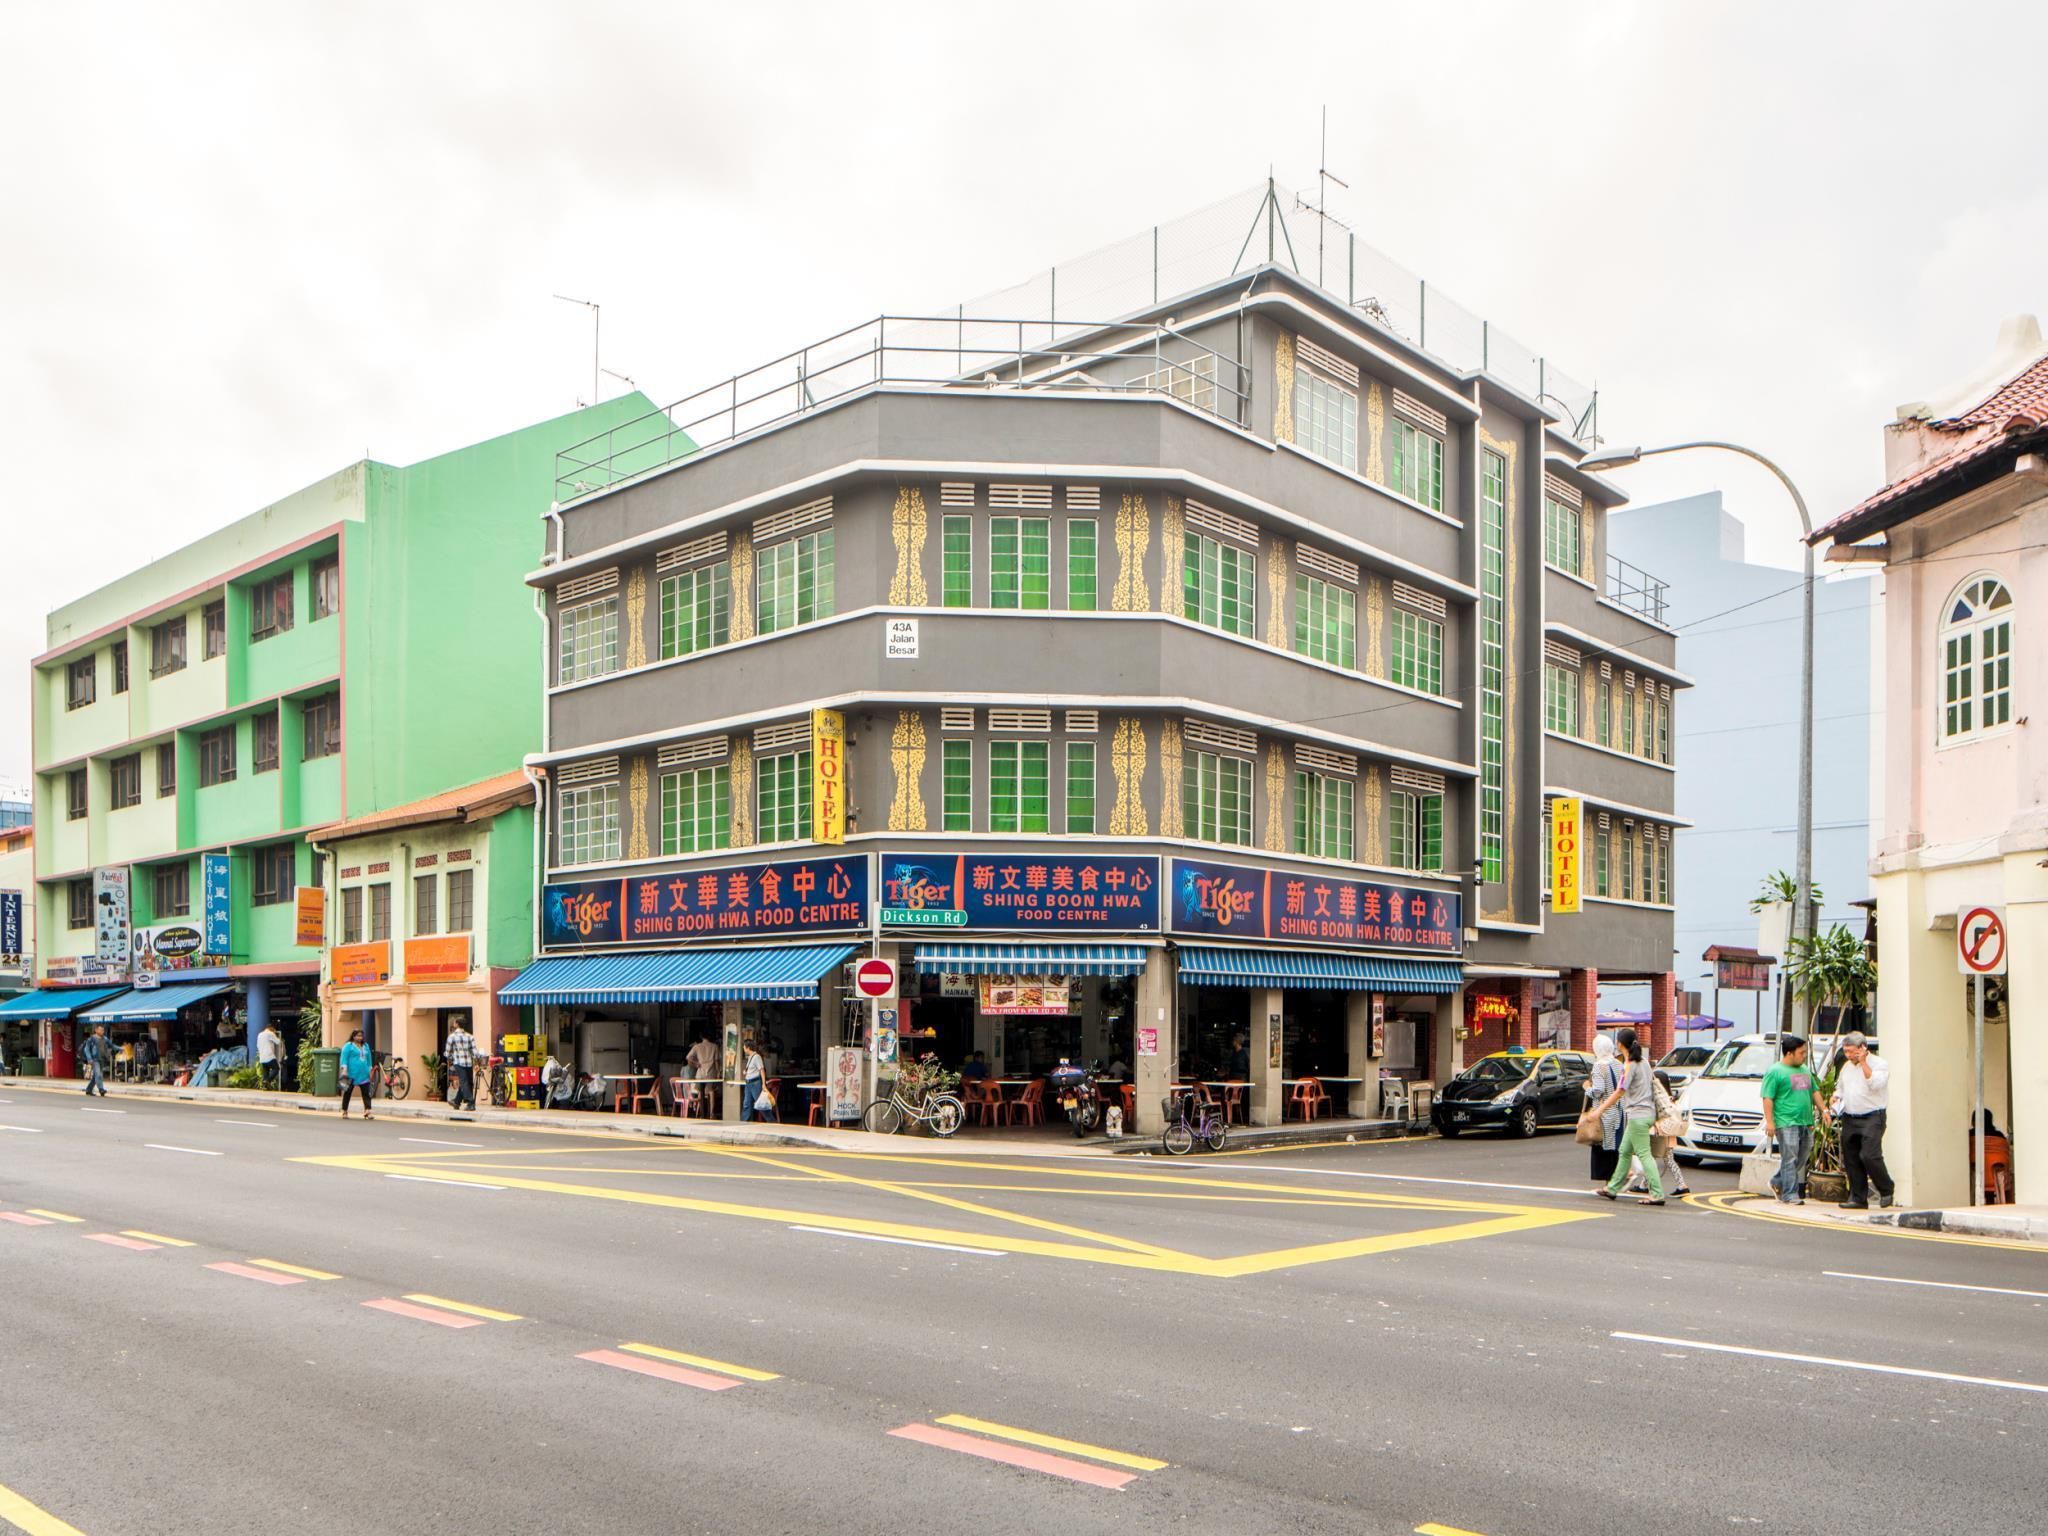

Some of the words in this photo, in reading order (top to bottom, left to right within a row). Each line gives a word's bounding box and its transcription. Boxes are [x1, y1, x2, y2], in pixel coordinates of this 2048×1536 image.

[890, 634, 915, 643] Jalan
[892, 622, 912, 631] 43A
[889, 645, 916, 654] Besar
[820, 738, 838, 840] HOTEL
[972, 864, 1152, 892] 新文華美食中心
[1557, 821, 1574, 905] HOTEL
[640, 863, 852, 914] 新文華美食中心
[885, 877, 950, 910] Tiger
[983, 893, 1038, 907] SHING
[1046, 894, 1095, 907] BOON
[1103, 894, 1142, 908] HWA
[1196, 877, 1255, 926] Tiger
[1286, 879, 1448, 928] 新文華美食中心
[4, 894, 17, 954] INTERNET
[562, 892, 612, 935] Tiger
[634, 916, 673, 934] SHING
[677, 913, 714, 932] BOON
[719, 911, 750, 930] HWA
[755, 908, 793, 926] FOOD
[799, 902, 860, 923] CENTRE
[883, 910, 938, 923] Dickson
[944, 912, 961, 924] Rd
[1017, 910, 1053, 920] FOOD
[1057, 910, 1108, 921] CENTRE
[1280, 916, 1318, 935] SHING
[1321, 920, 1353, 938] BOON
[1357, 923, 1381, 941] HWA
[1384, 925, 1413, 943] FOOD
[1415, 928, 1453, 946] CENTRE
[2, 954, 21, 965] 24
